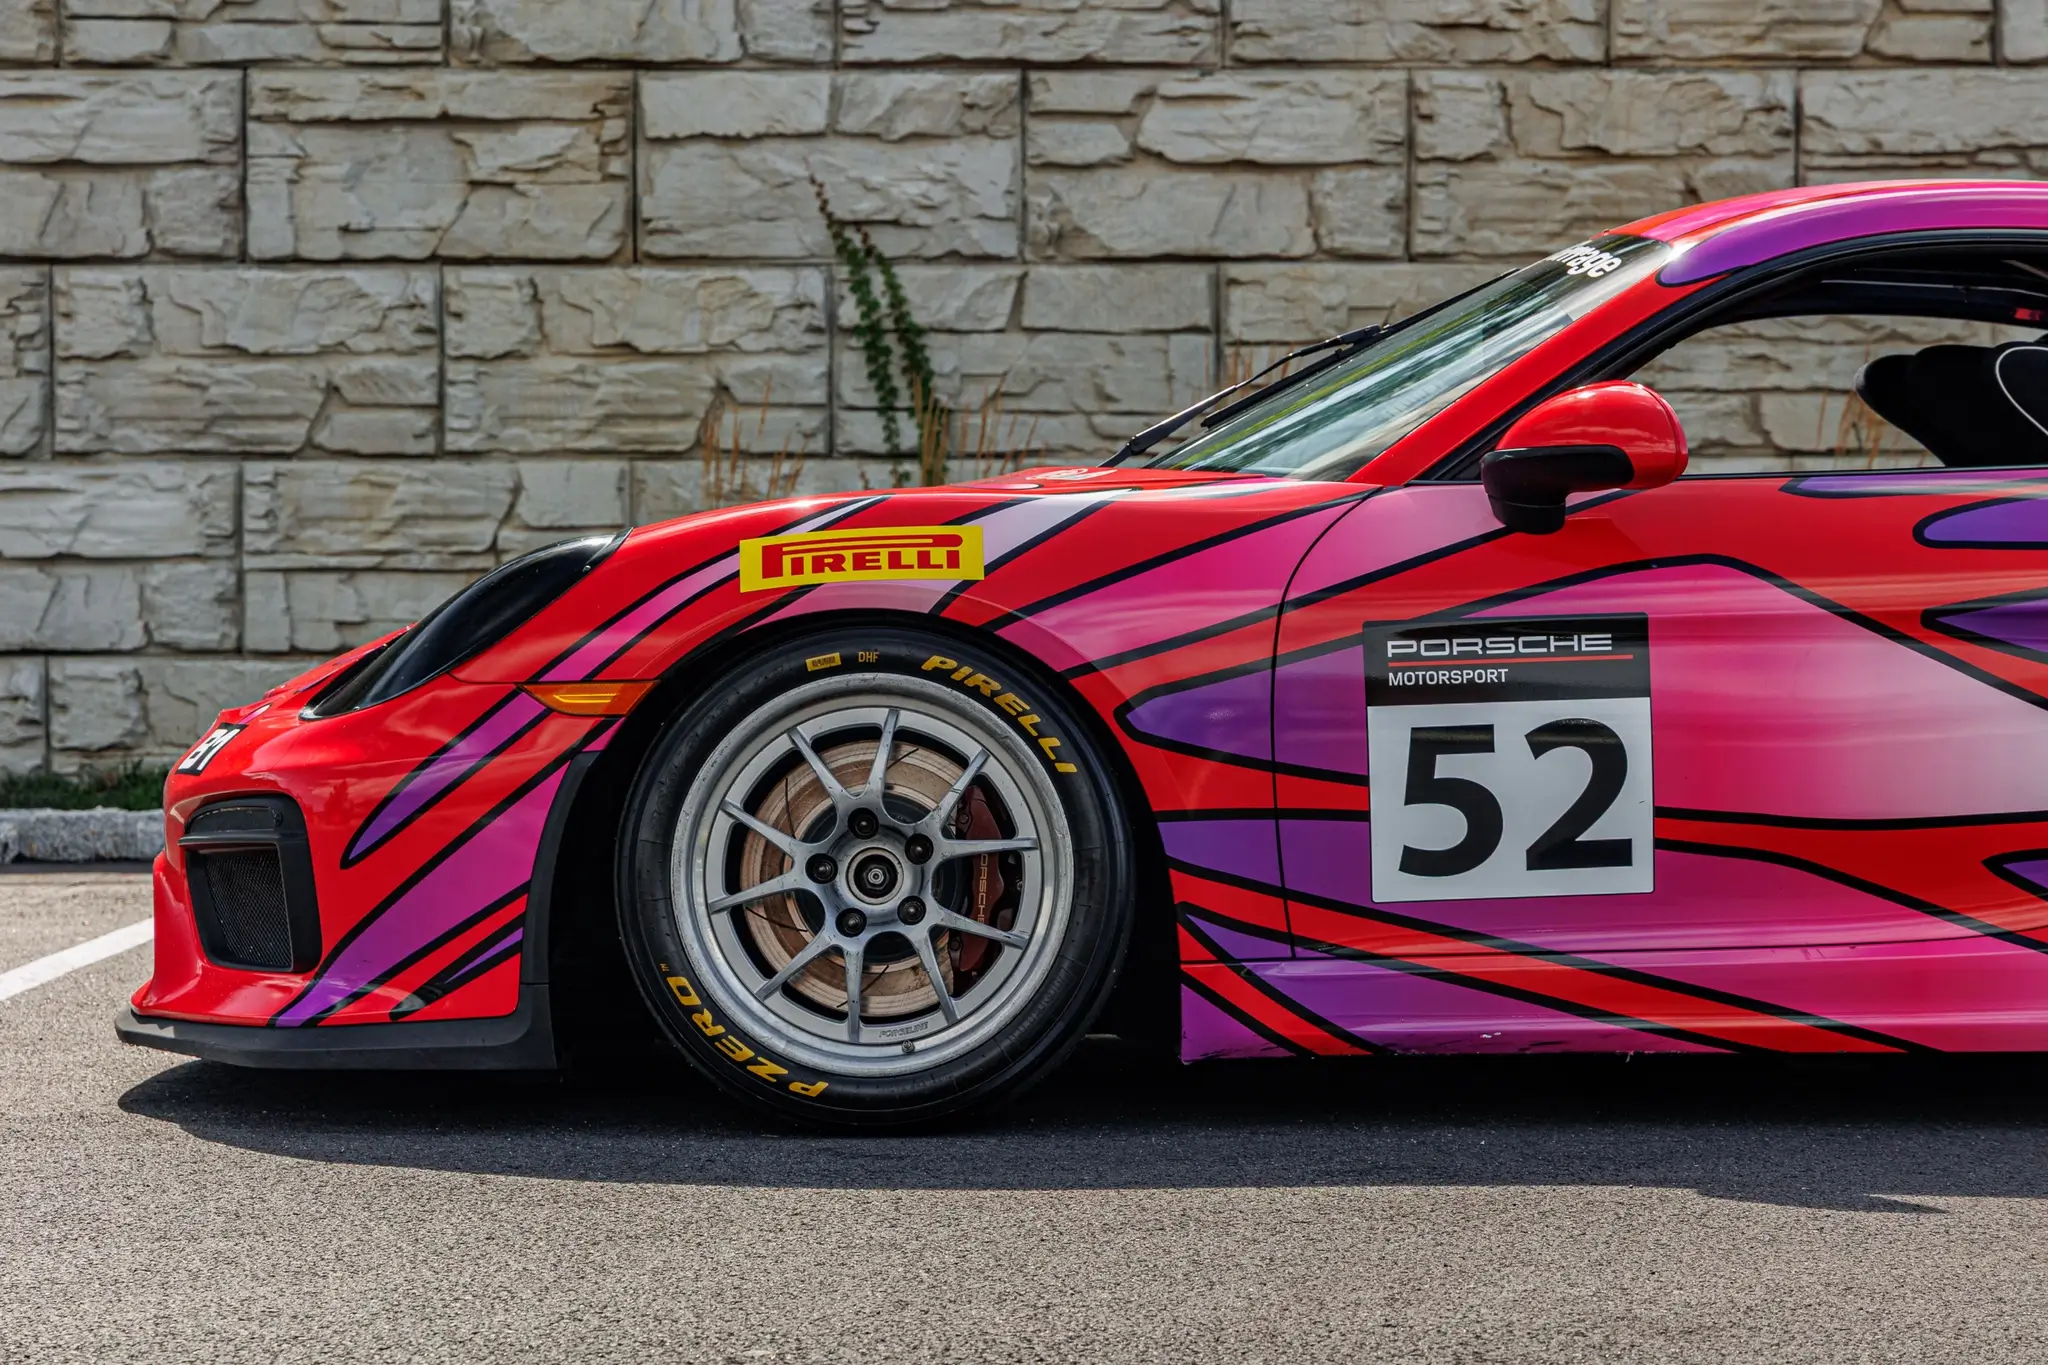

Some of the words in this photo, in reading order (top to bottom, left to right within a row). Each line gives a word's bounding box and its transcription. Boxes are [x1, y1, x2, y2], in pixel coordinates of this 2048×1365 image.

[762, 534, 964, 579] PIRELLI
[858, 651, 880, 663] DHF
[1387, 633, 1613, 657] PORSCHE
[1388, 668, 1509, 686] MOTORSPORT
[921, 655, 1078, 773] PIRELLI
[1398, 717, 1633, 878] 52
